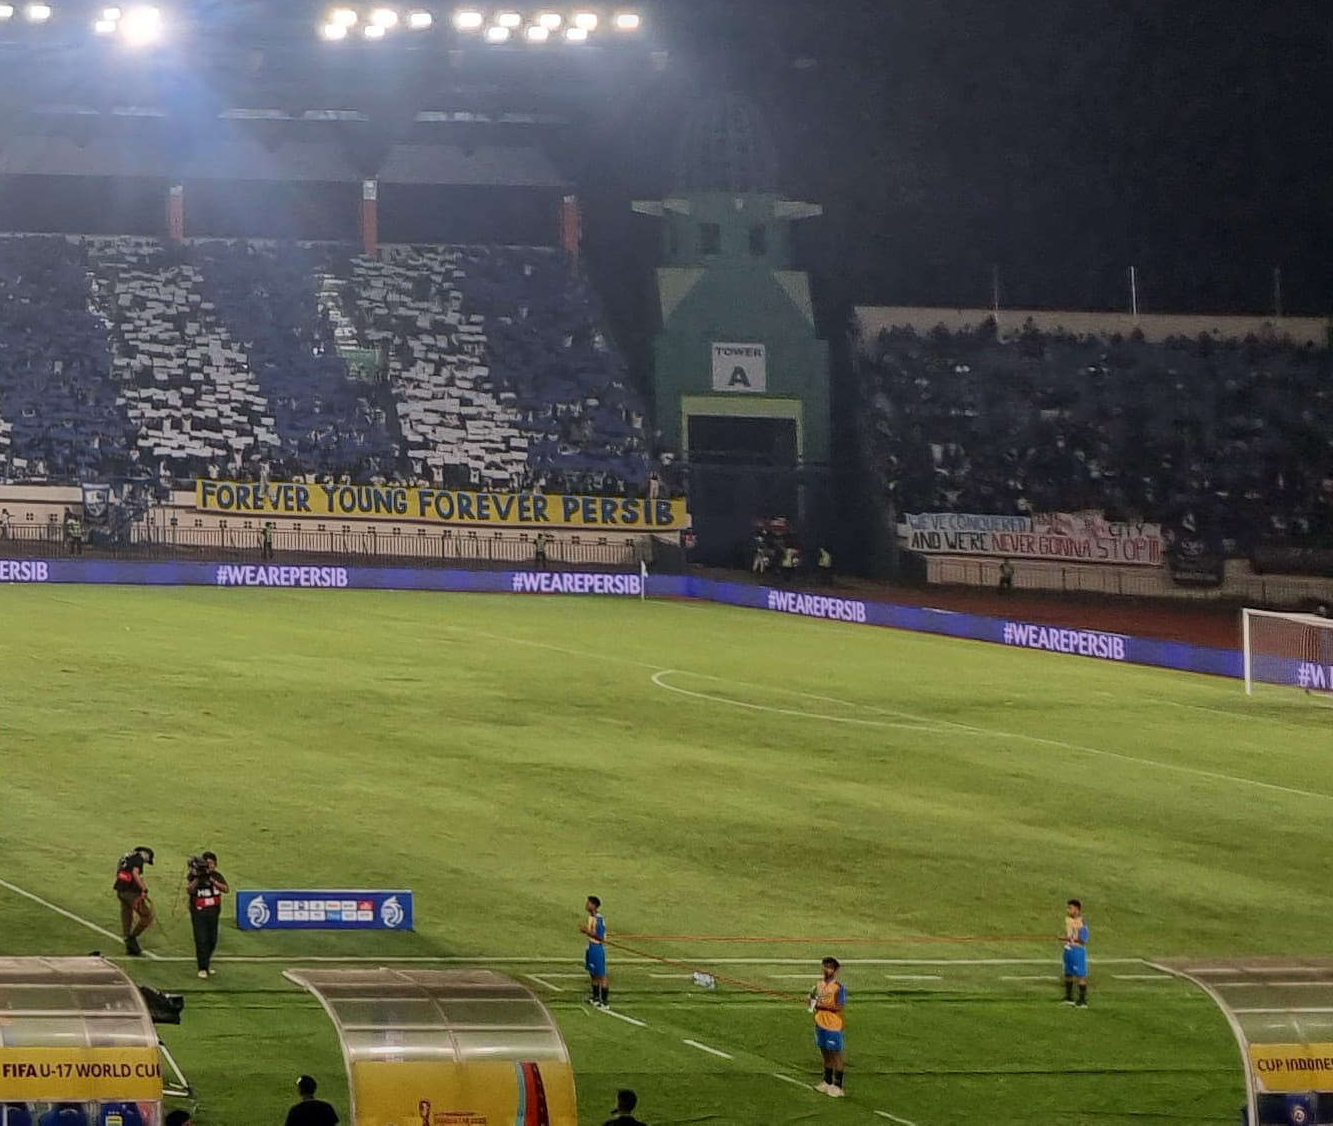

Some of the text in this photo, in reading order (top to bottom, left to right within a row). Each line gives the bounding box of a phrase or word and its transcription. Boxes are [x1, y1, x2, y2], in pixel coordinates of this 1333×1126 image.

[715, 346, 762, 357] TOWER
[728, 366, 751, 387] A
[202, 482, 674, 526] FOREVER YOUNG FOREVER PERSIB
[911, 532, 941, 549] AND
[991, 533, 1036, 554] NEVER
[1039, 536, 1093, 558] GONNA
[217, 565, 348, 587] #WEAREPERSIB
[512, 571, 640, 594] #WEAREPERSIB
[768, 590, 866, 622] #WEAREPERSIB
[1003, 622, 1124, 660] #WEAREPERSIB
[3, 1064, 37, 1078] FIFA
[40, 1064, 72, 1078] U-17
[76, 1064, 131, 1078] WORLD
[1258, 1058, 1283, 1071] CUP
